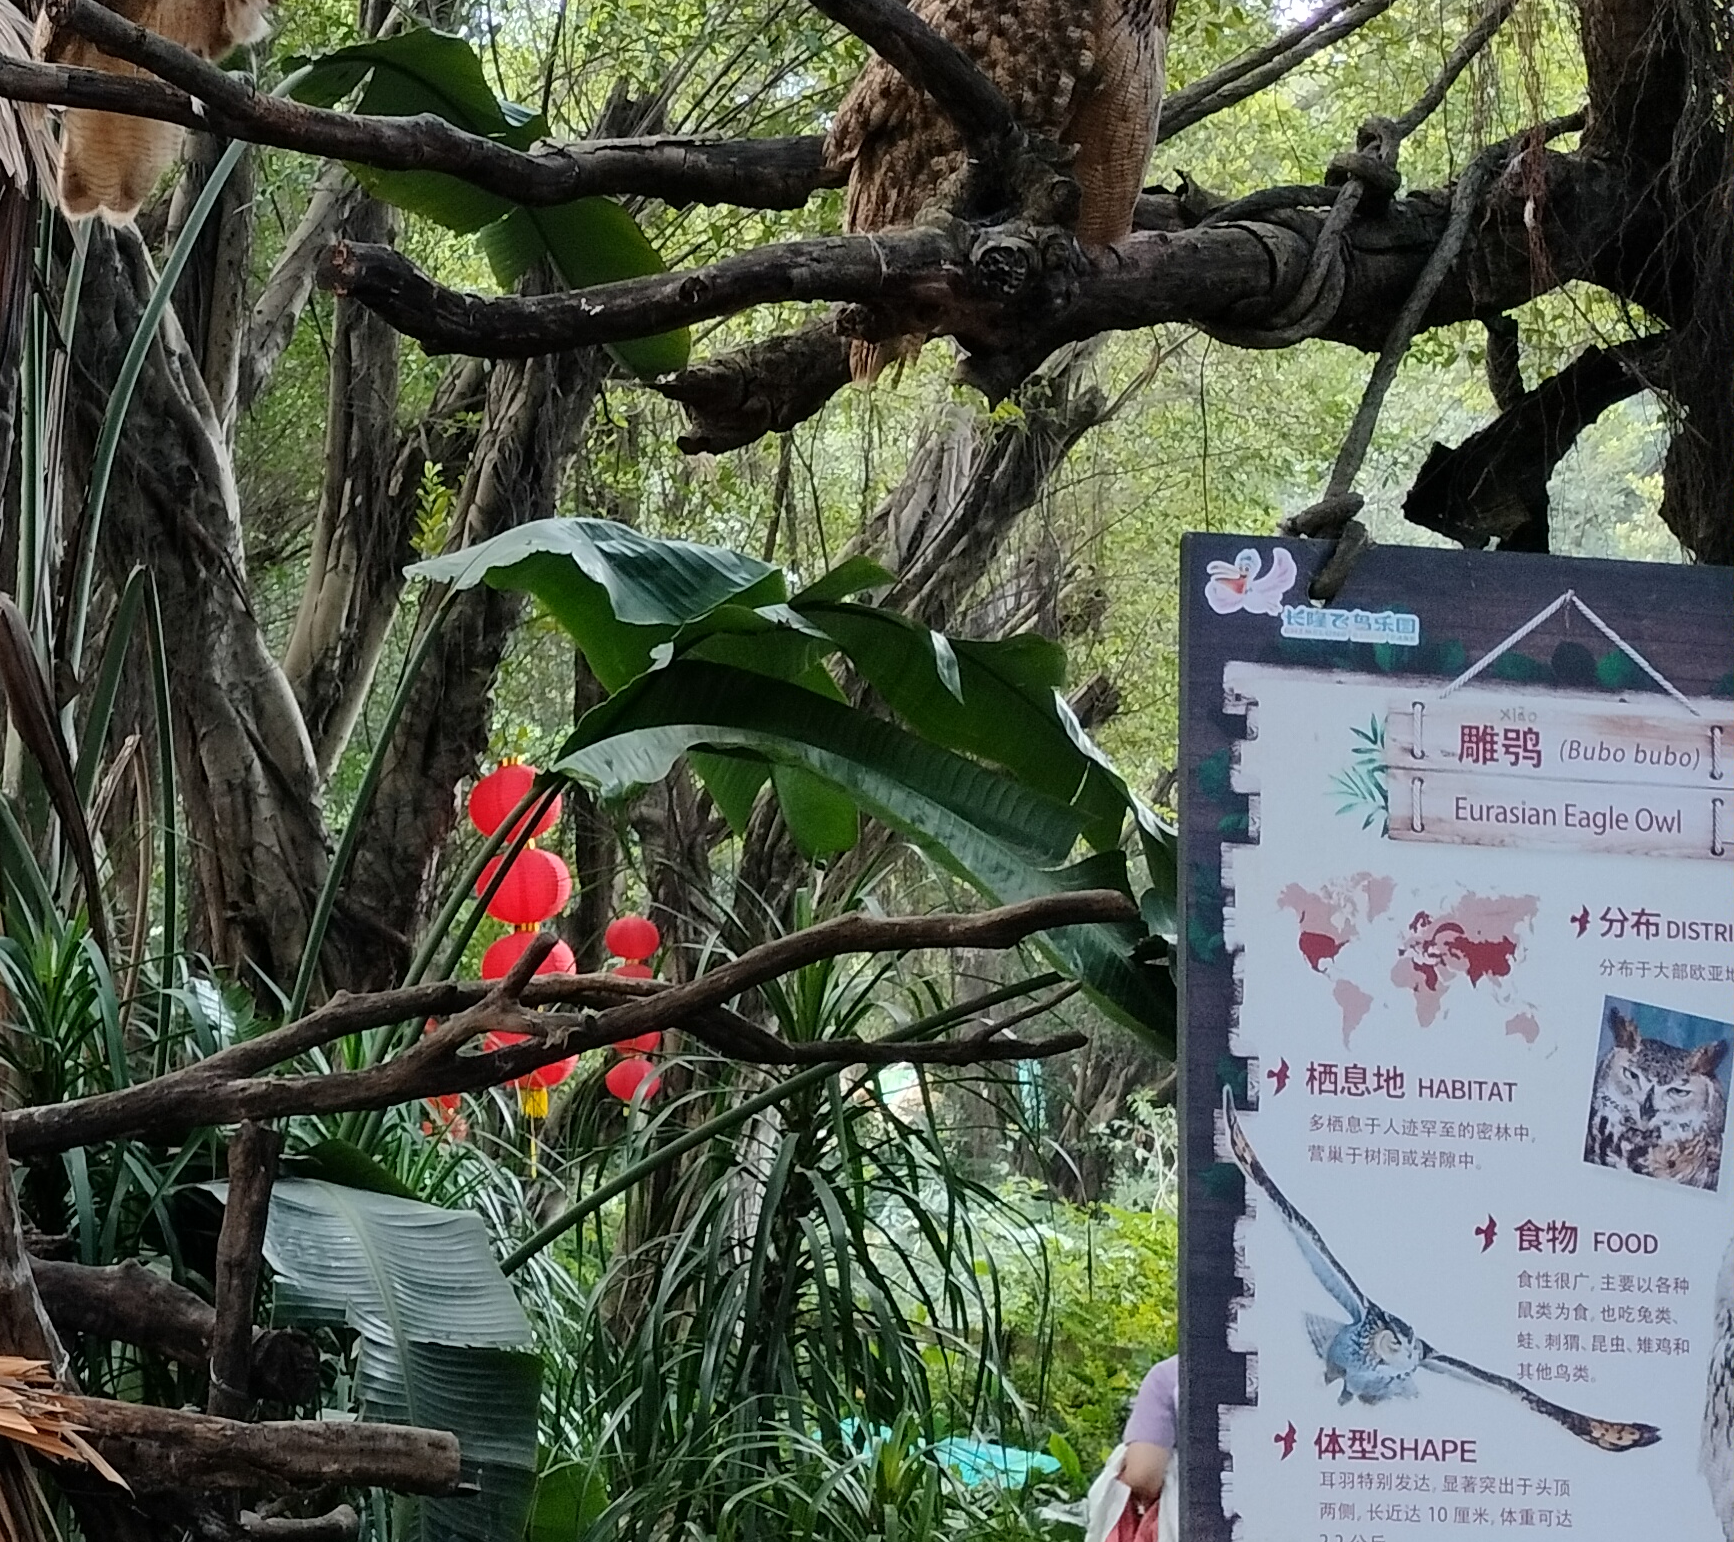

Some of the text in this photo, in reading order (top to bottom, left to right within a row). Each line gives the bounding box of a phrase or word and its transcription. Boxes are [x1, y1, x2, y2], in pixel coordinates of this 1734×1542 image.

[1458, 724, 1701, 770] 雕鸮 (Bubo bubo)
[1454, 796, 1682, 835] Eurasian Eagle Owl
[1599, 906, 1733, 942] 分布 DISTRI
[1306, 1061, 1518, 1103] 栖息地 HABITAT
[1514, 1219, 1659, 1254] 食物 FOOD
[1314, 1426, 1478, 1463] 体型 SHAPE
[1429, 1507, 1448, 1523] 10
